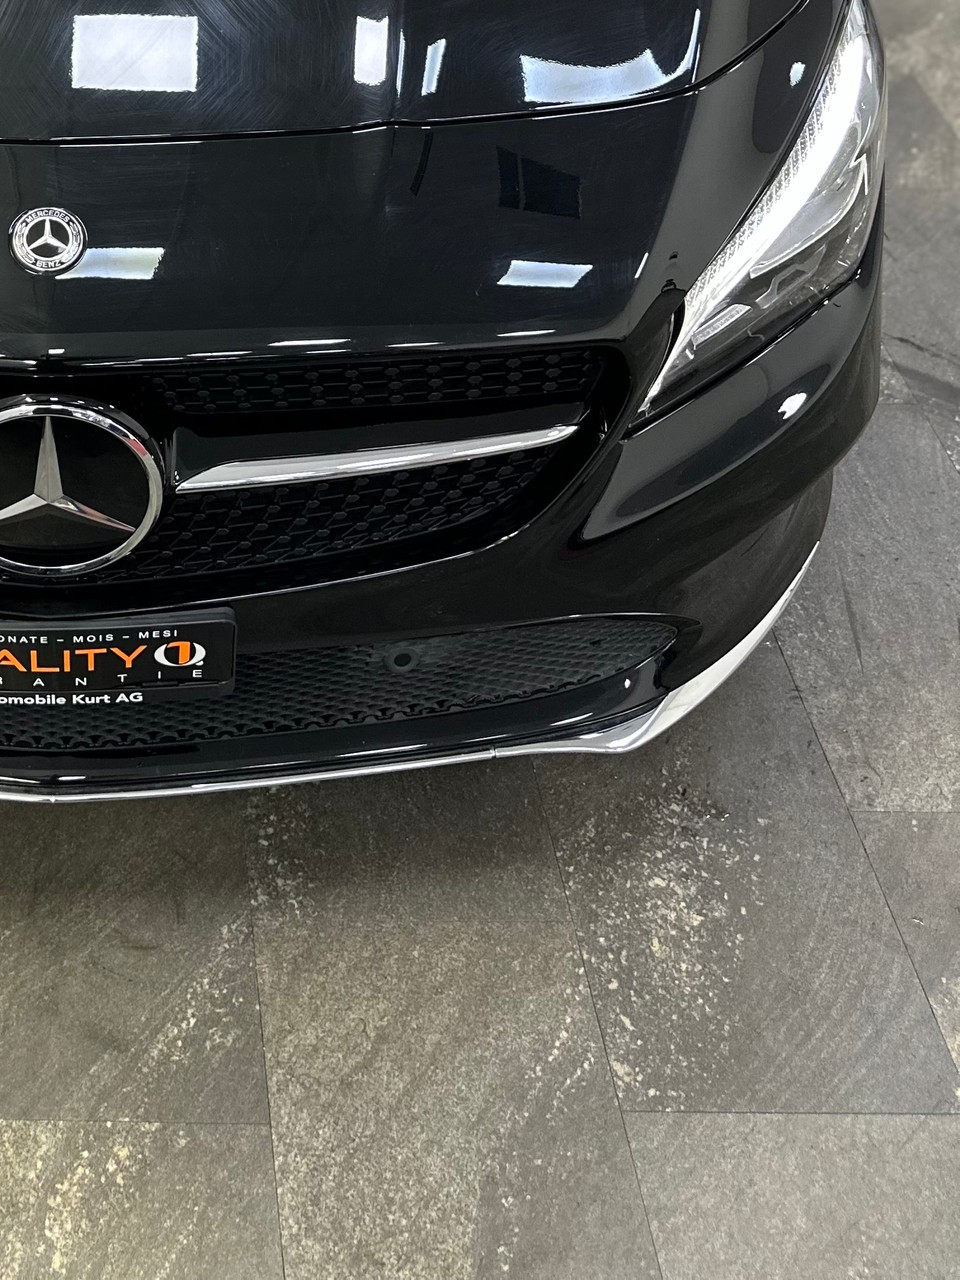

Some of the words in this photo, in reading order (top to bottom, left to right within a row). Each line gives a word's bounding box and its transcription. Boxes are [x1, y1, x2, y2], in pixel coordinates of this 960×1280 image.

[25, 209, 70, 223] MERCEDES
[36, 260, 61, 268] BENZ
[73, 634, 114, 644] MOIS
[138, 629, 178, 639] MESI
[72, 694, 111, 705] Kurt
[115, 692, 144, 702] AG
